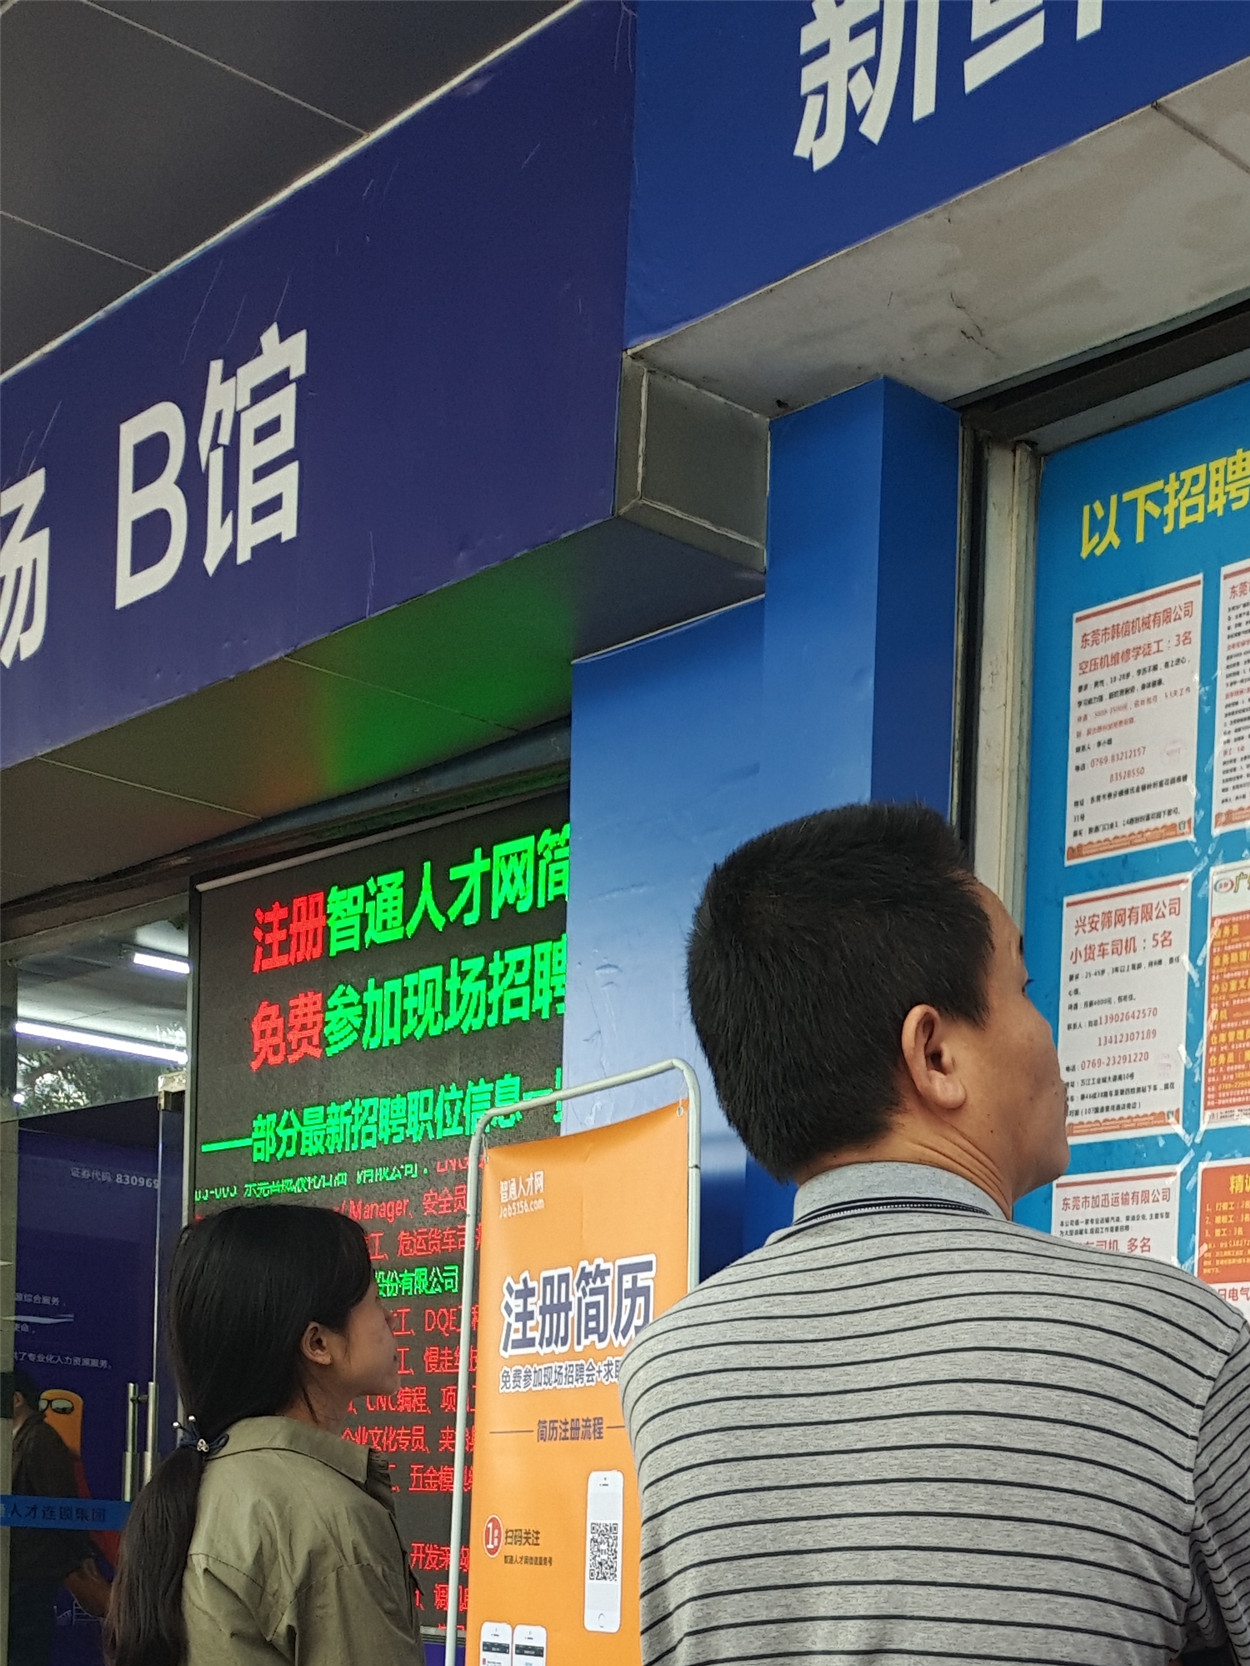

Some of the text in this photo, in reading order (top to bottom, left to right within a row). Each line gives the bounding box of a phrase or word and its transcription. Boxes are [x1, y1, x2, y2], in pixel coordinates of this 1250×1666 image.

[115, 323, 307, 610] B馆
[252, 822, 570, 973] 注册智通人才网简
[1074, 897, 1181, 936] 兴安筛网有限公司
[250, 933, 567, 1071] 免费参加现场招聘
[500, 1171, 544, 1203] 智通人才网
[500, 1254, 656, 1356] 注册简历
[536, 1417, 604, 1443] 简历注册流程
[505, 1528, 541, 1546] 扫码关注
